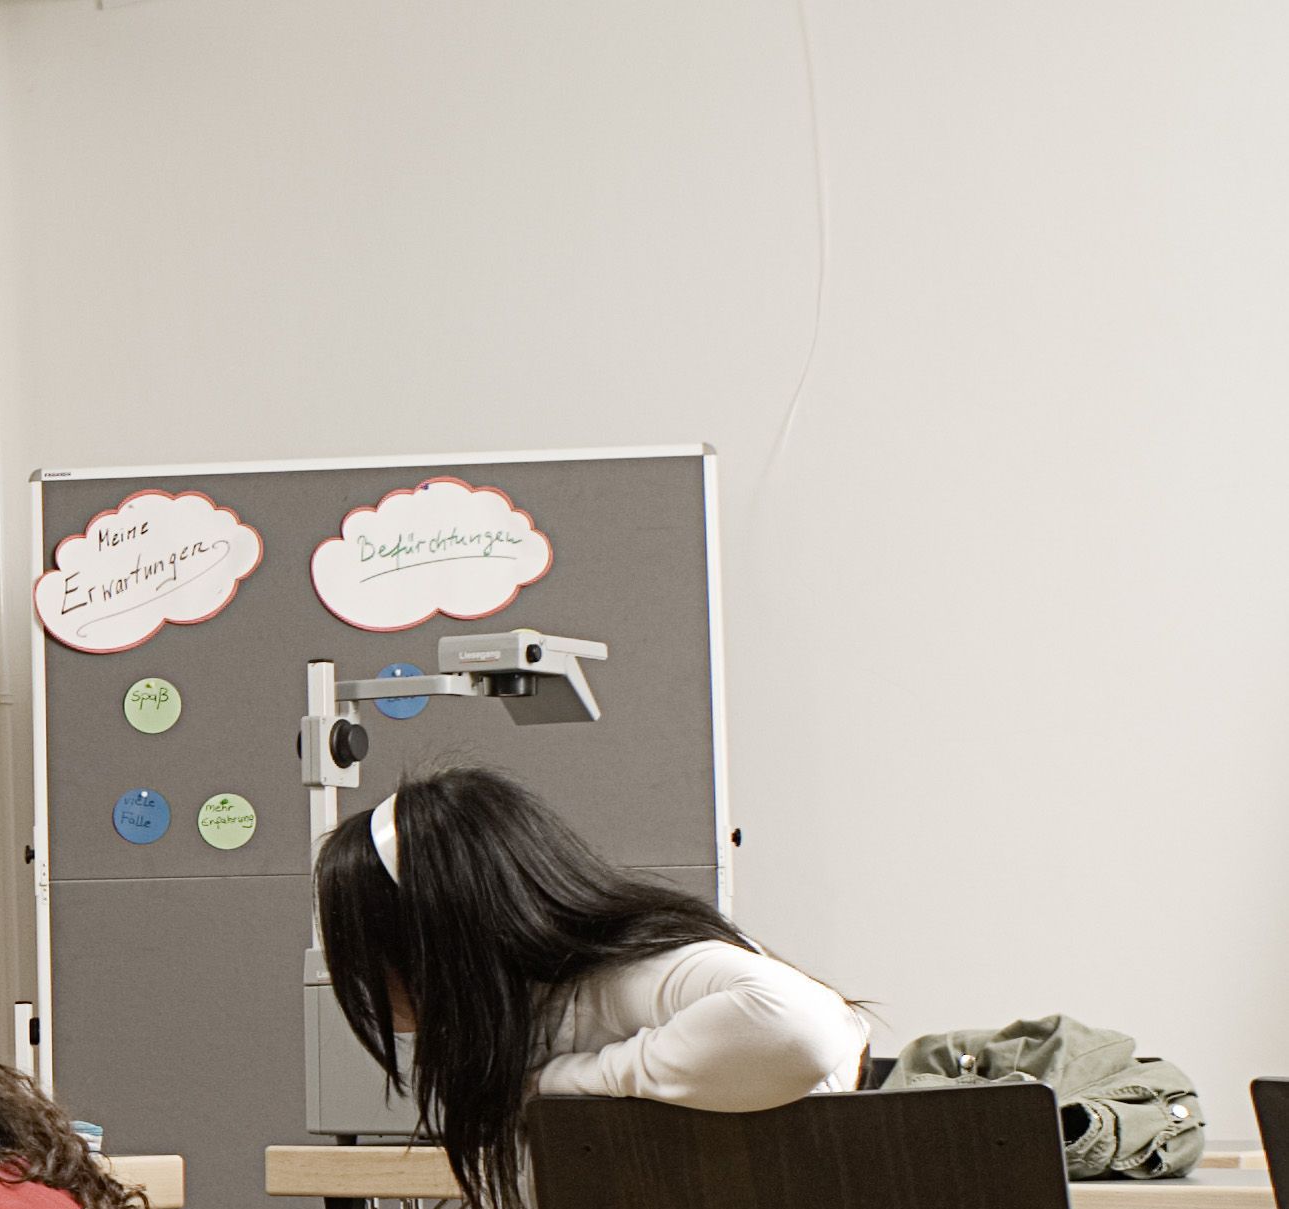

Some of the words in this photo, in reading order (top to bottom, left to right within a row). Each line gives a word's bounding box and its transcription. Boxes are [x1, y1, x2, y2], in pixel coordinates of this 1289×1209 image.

[98, 521, 149, 551] Meine
[357, 527, 522, 568] Befürchtungen
[62, 541, 209, 615] Erwartungen
